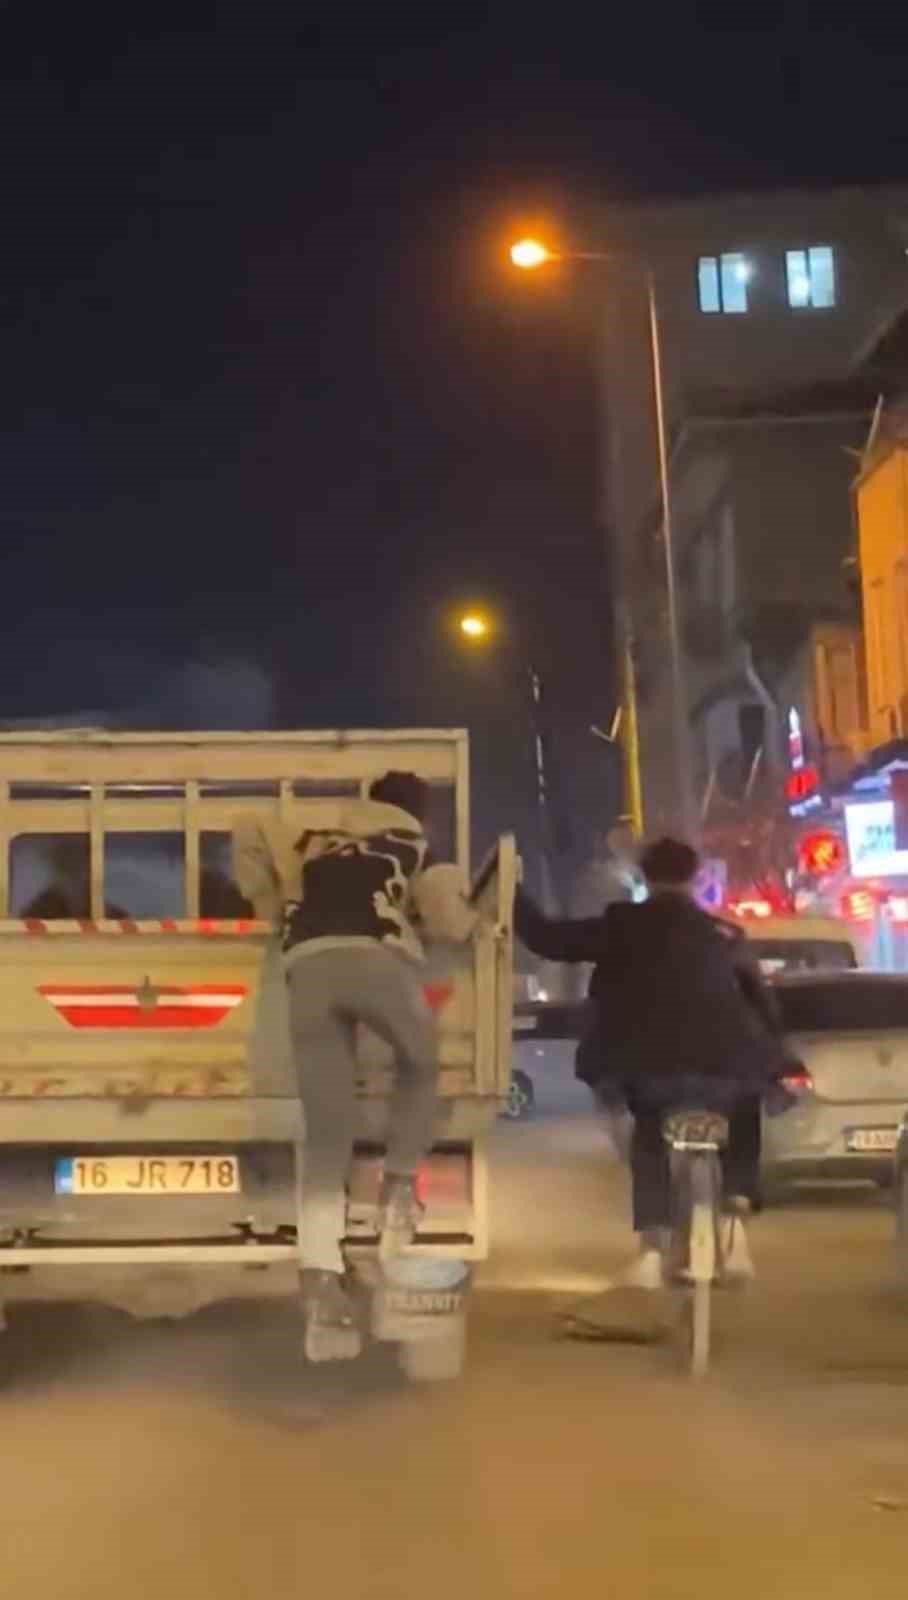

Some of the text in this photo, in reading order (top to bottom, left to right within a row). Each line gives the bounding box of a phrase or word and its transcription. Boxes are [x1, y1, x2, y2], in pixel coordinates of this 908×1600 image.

[76, 1159, 235, 1189] 16 JR 718
